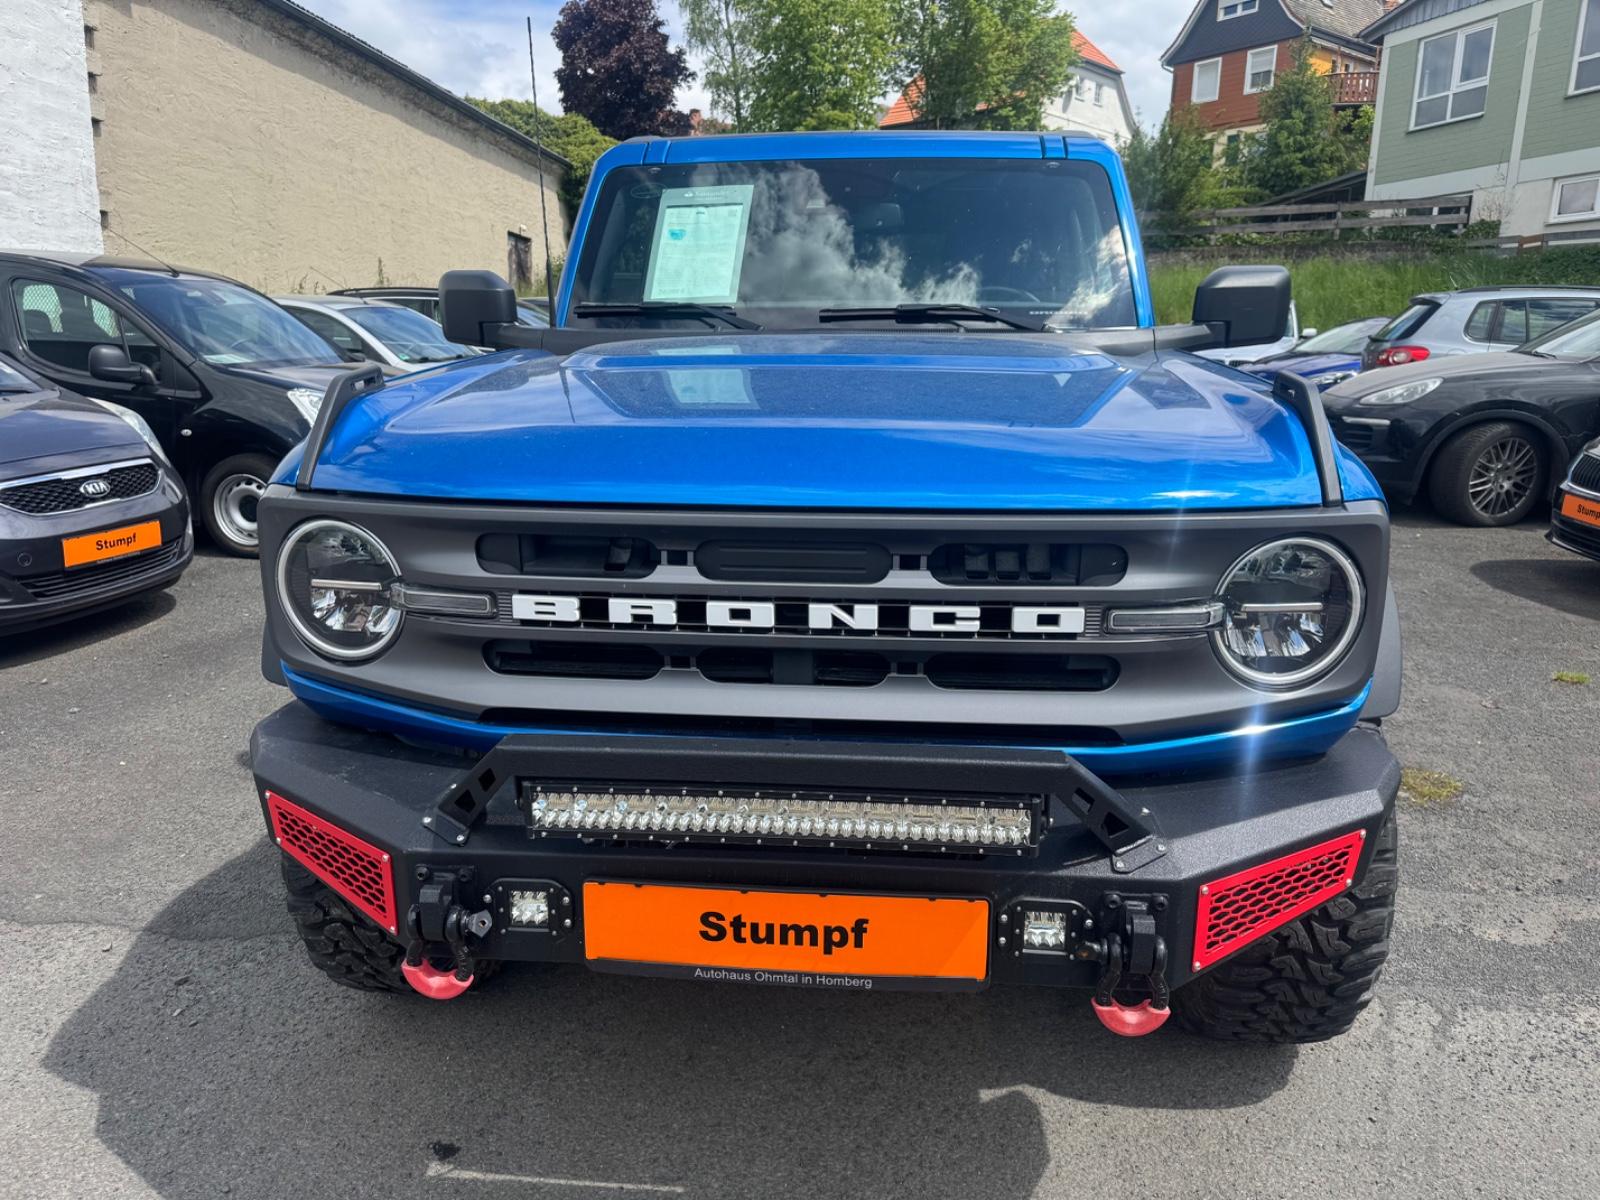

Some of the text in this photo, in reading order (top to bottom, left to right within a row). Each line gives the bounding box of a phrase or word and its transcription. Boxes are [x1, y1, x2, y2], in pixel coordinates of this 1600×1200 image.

[85, 482, 107, 494] KIA
[95, 533, 137, 551] Stumpf
[511, 594, 1085, 633] BRONCO
[699, 911, 870, 955] Stumpf
[694, 968, 873, 989] Autohaus Ohmtal in Homberg
